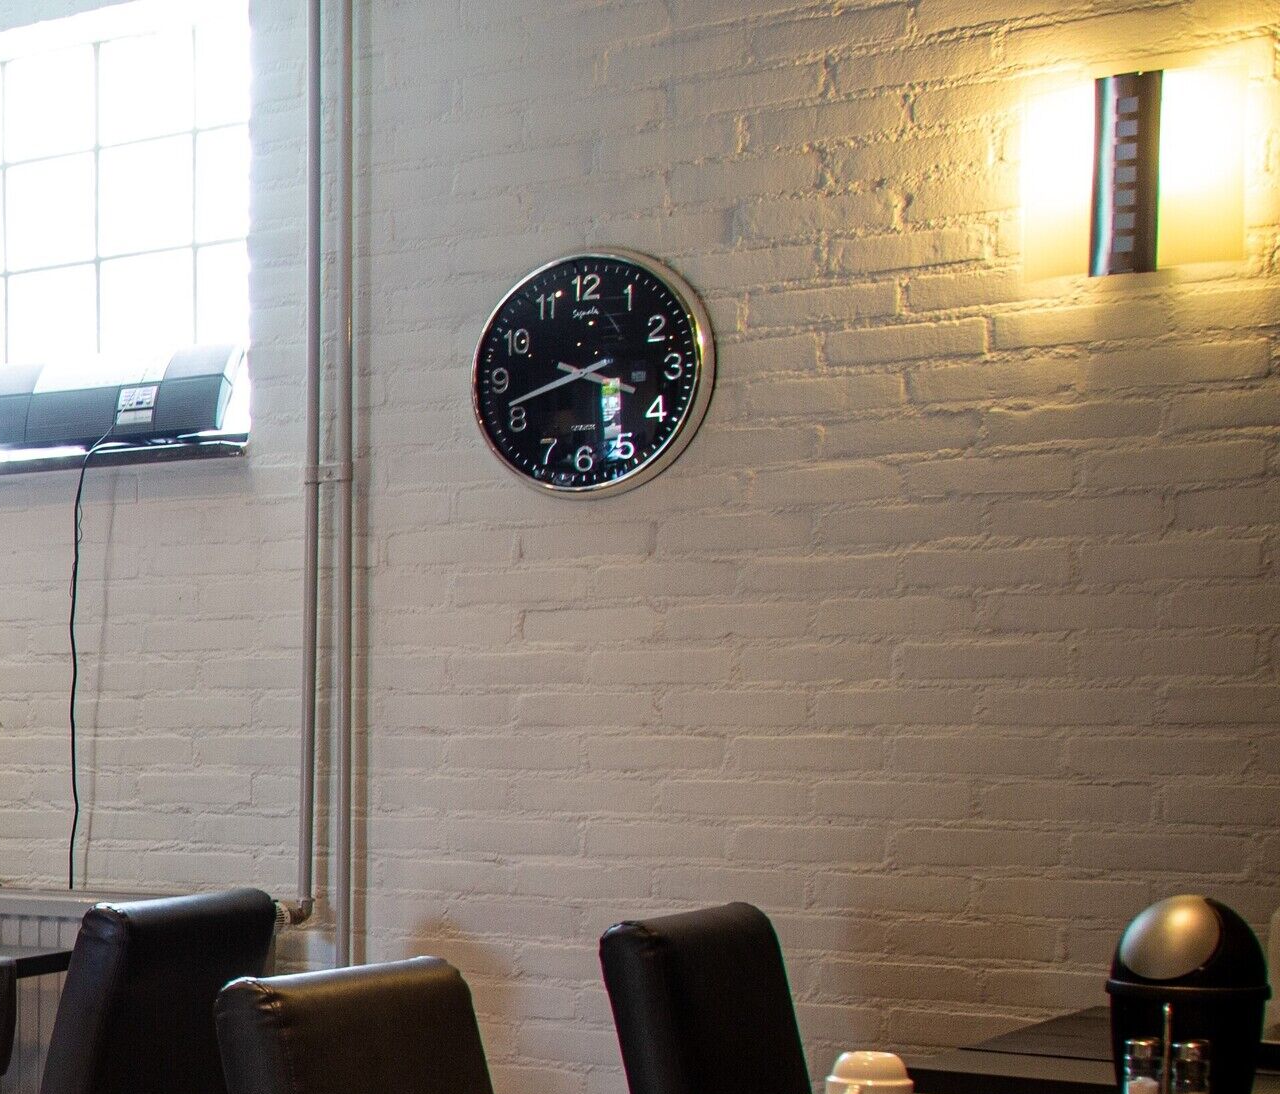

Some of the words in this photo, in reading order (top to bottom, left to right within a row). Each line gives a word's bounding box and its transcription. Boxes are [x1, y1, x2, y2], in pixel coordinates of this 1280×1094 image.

[571, 273, 601, 302] 12
[623, 284, 633, 312] 1
[536, 293, 556, 320] 11
[647, 314, 667, 342] 2
[504, 328, 529, 357] 10
[663, 352, 683, 380] 3
[491, 367, 510, 394] 9
[510, 406, 527, 432] 8
[645, 394, 668, 423] 4
[540, 437, 558, 465] 7
[576, 445, 593, 472] 6
[615, 432, 635, 460] 5
